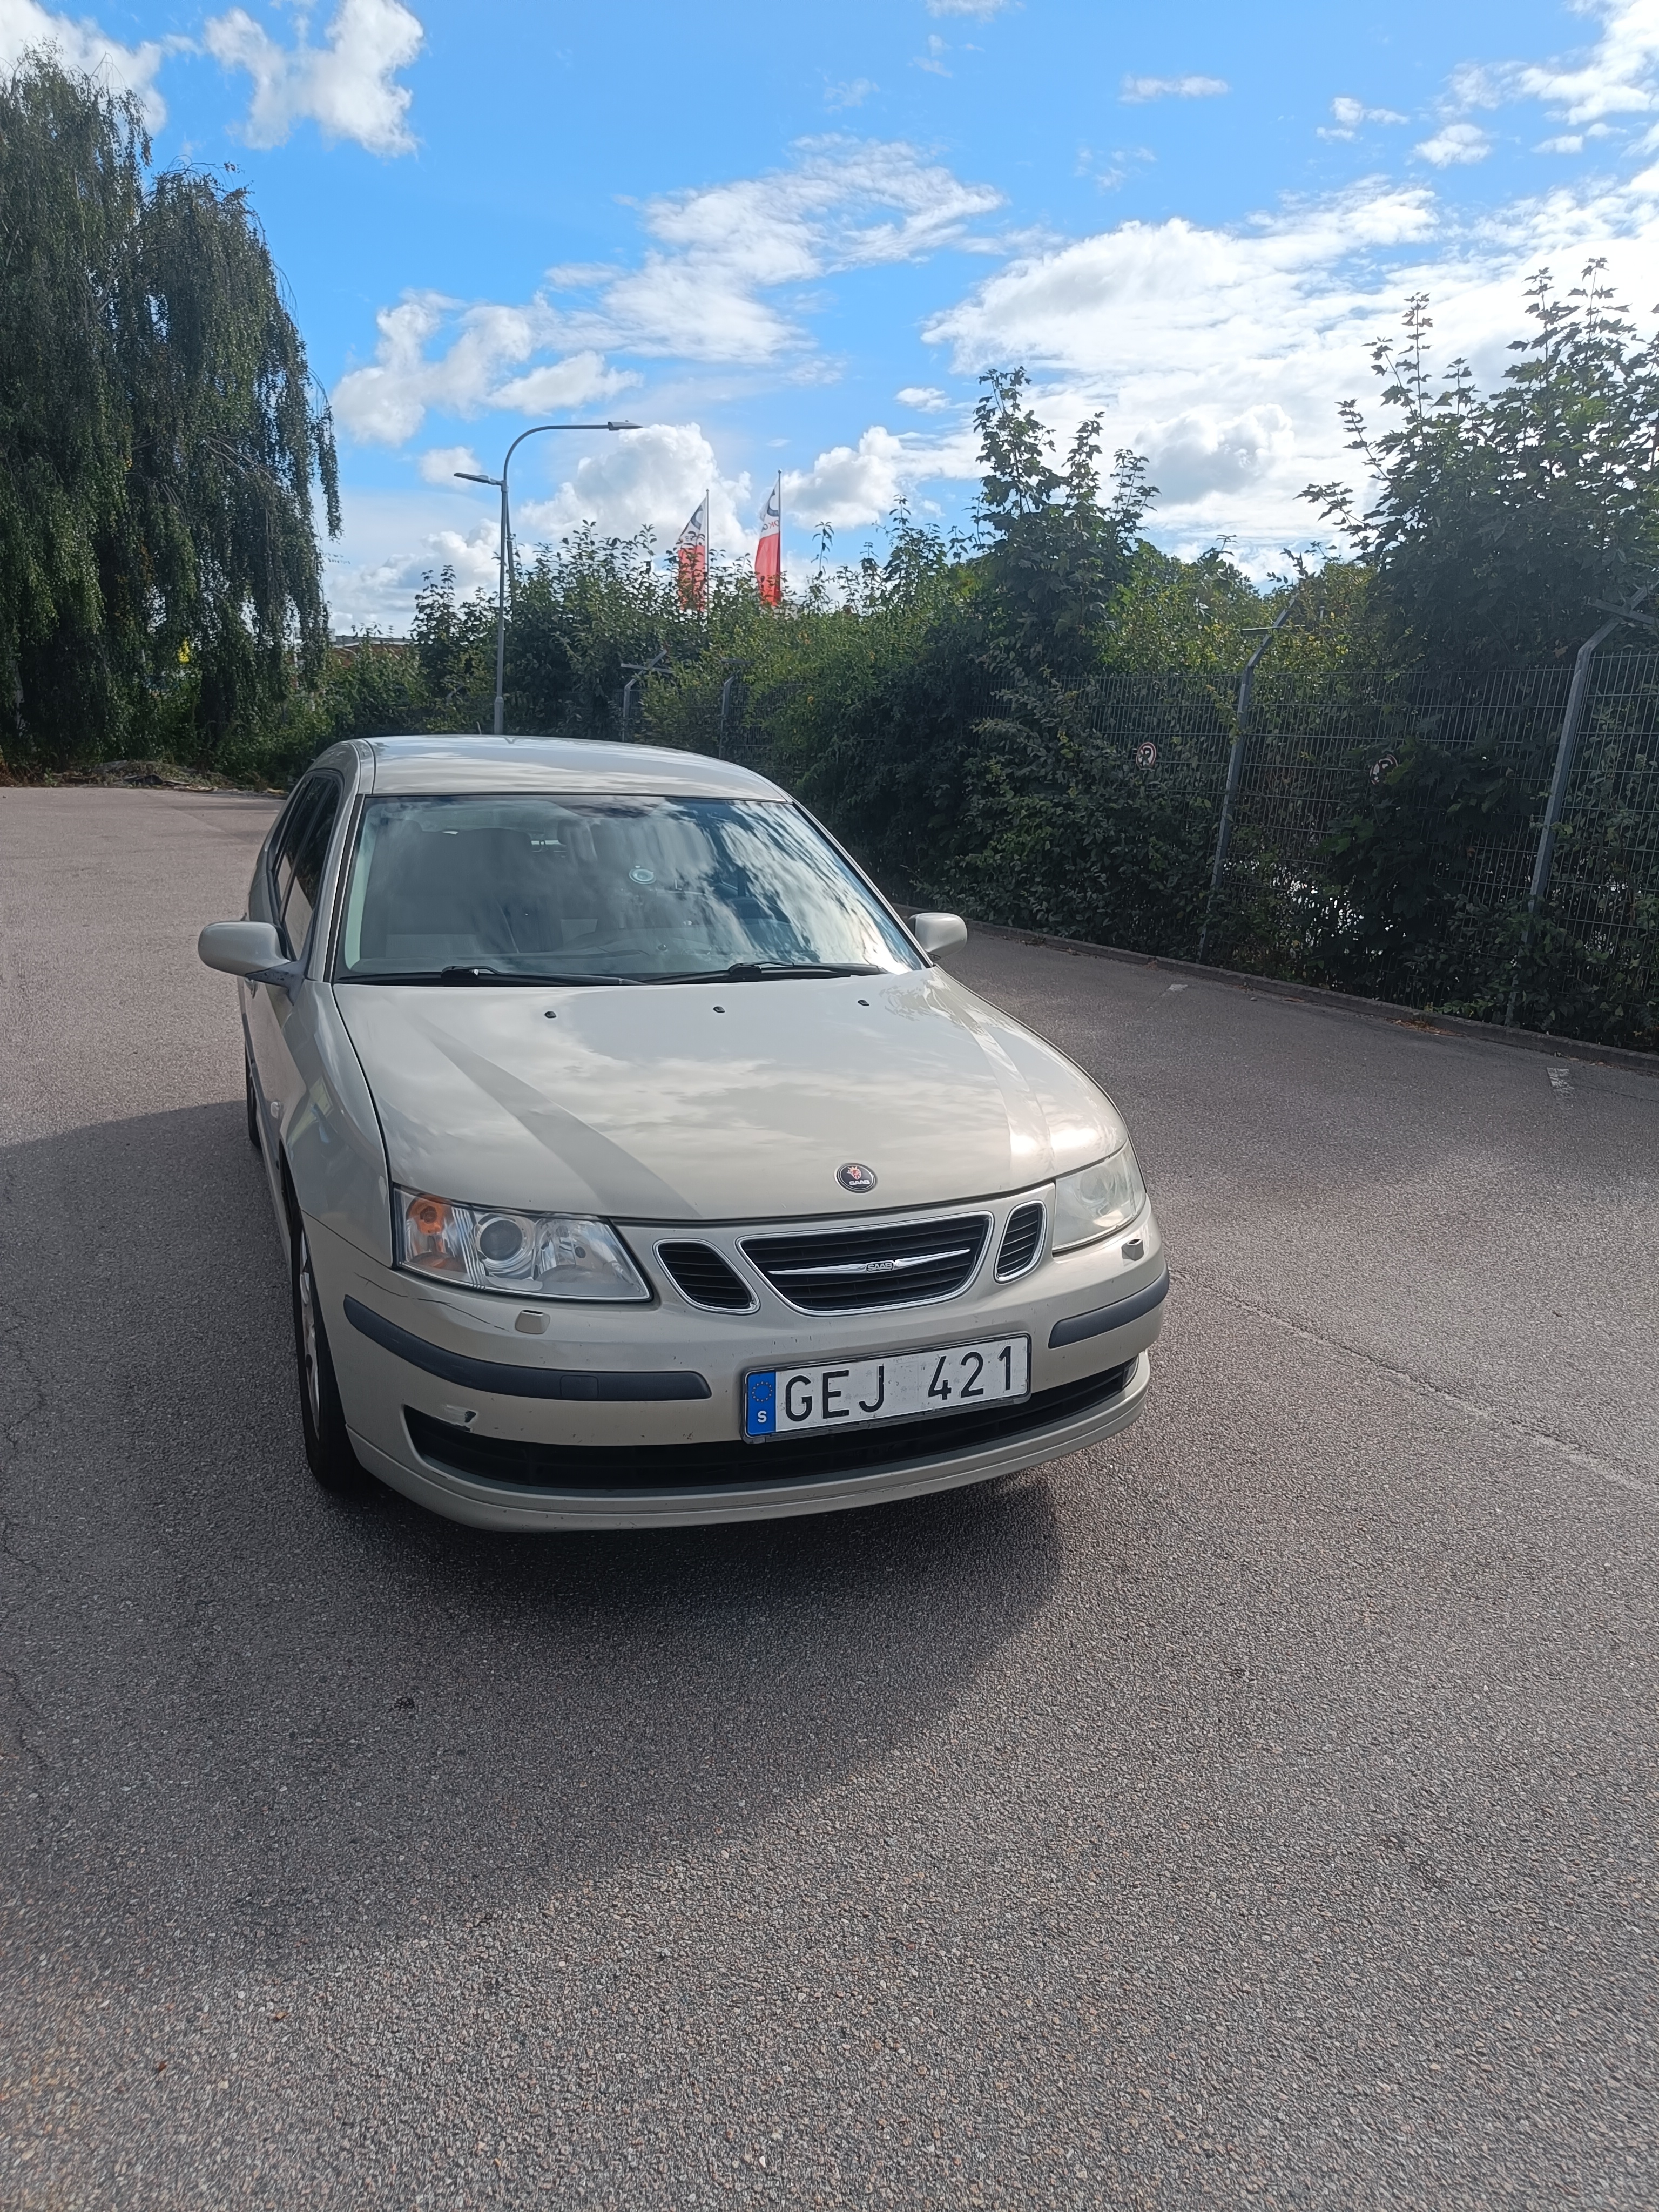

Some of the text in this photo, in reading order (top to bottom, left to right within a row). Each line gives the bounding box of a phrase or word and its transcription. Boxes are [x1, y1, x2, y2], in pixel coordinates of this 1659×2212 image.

[867, 1263, 893, 1271] SAAB
[785, 1345, 1012, 1422] GEJ 421
[757, 1410, 767, 1424] S
